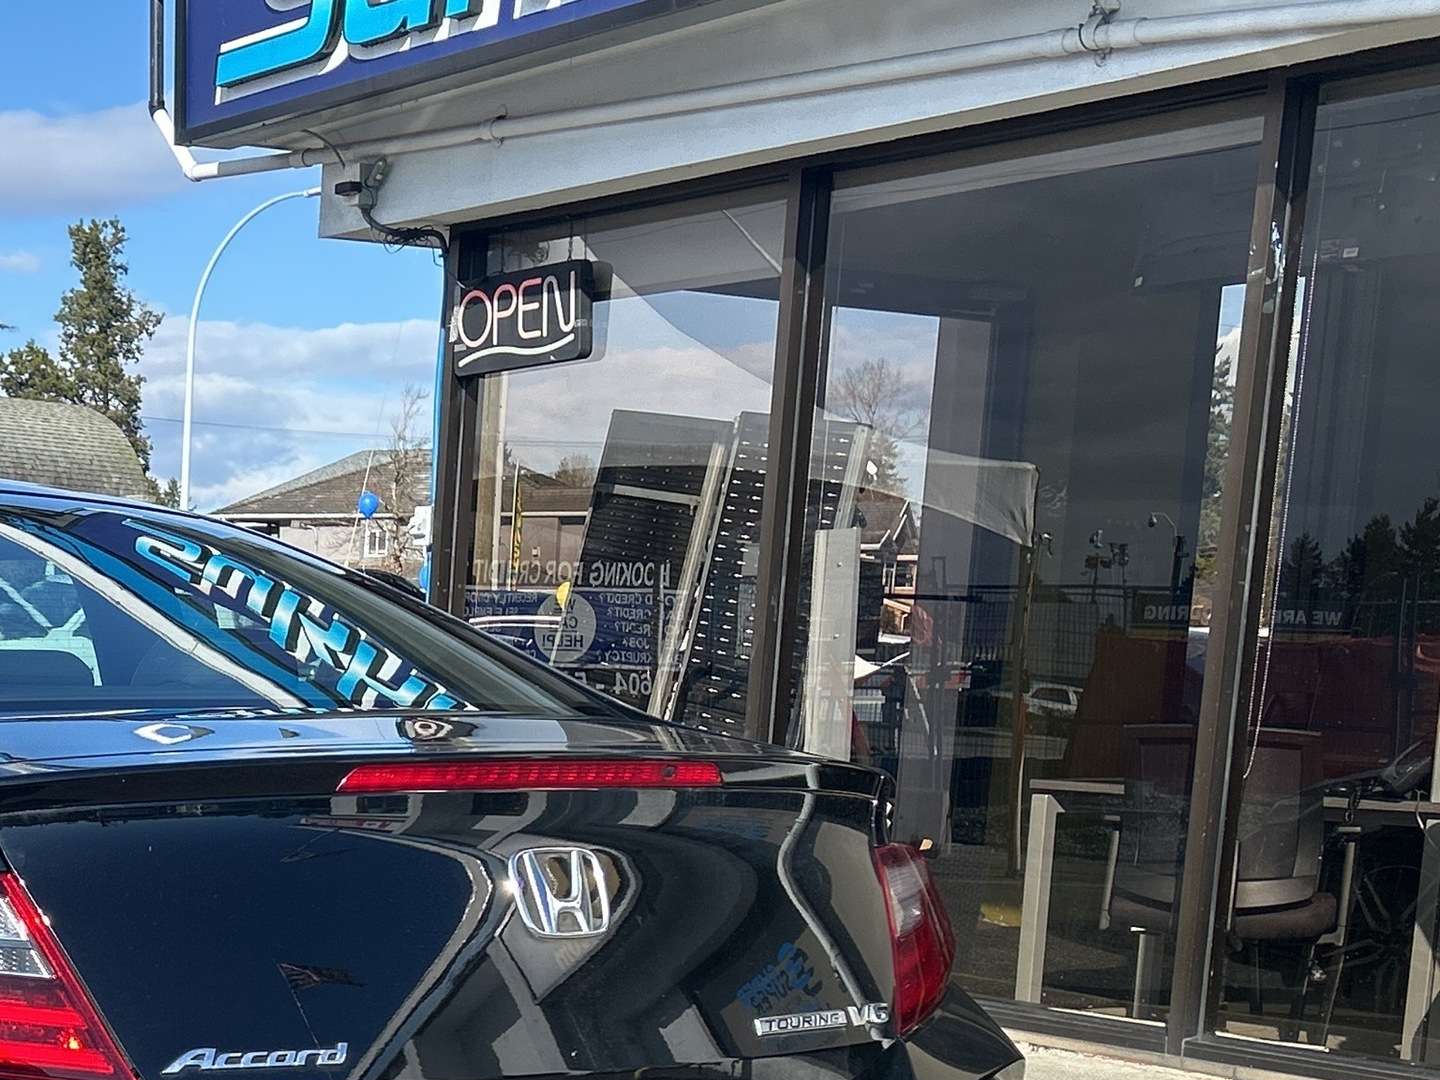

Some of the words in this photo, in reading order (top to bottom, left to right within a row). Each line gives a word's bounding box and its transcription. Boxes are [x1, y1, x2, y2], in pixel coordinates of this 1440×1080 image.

[458, 270, 576, 348] OPEN
[766, 1012, 841, 1031] TOURING
[848, 1003, 890, 1027] V6
[161, 1042, 349, 1075] Accord
